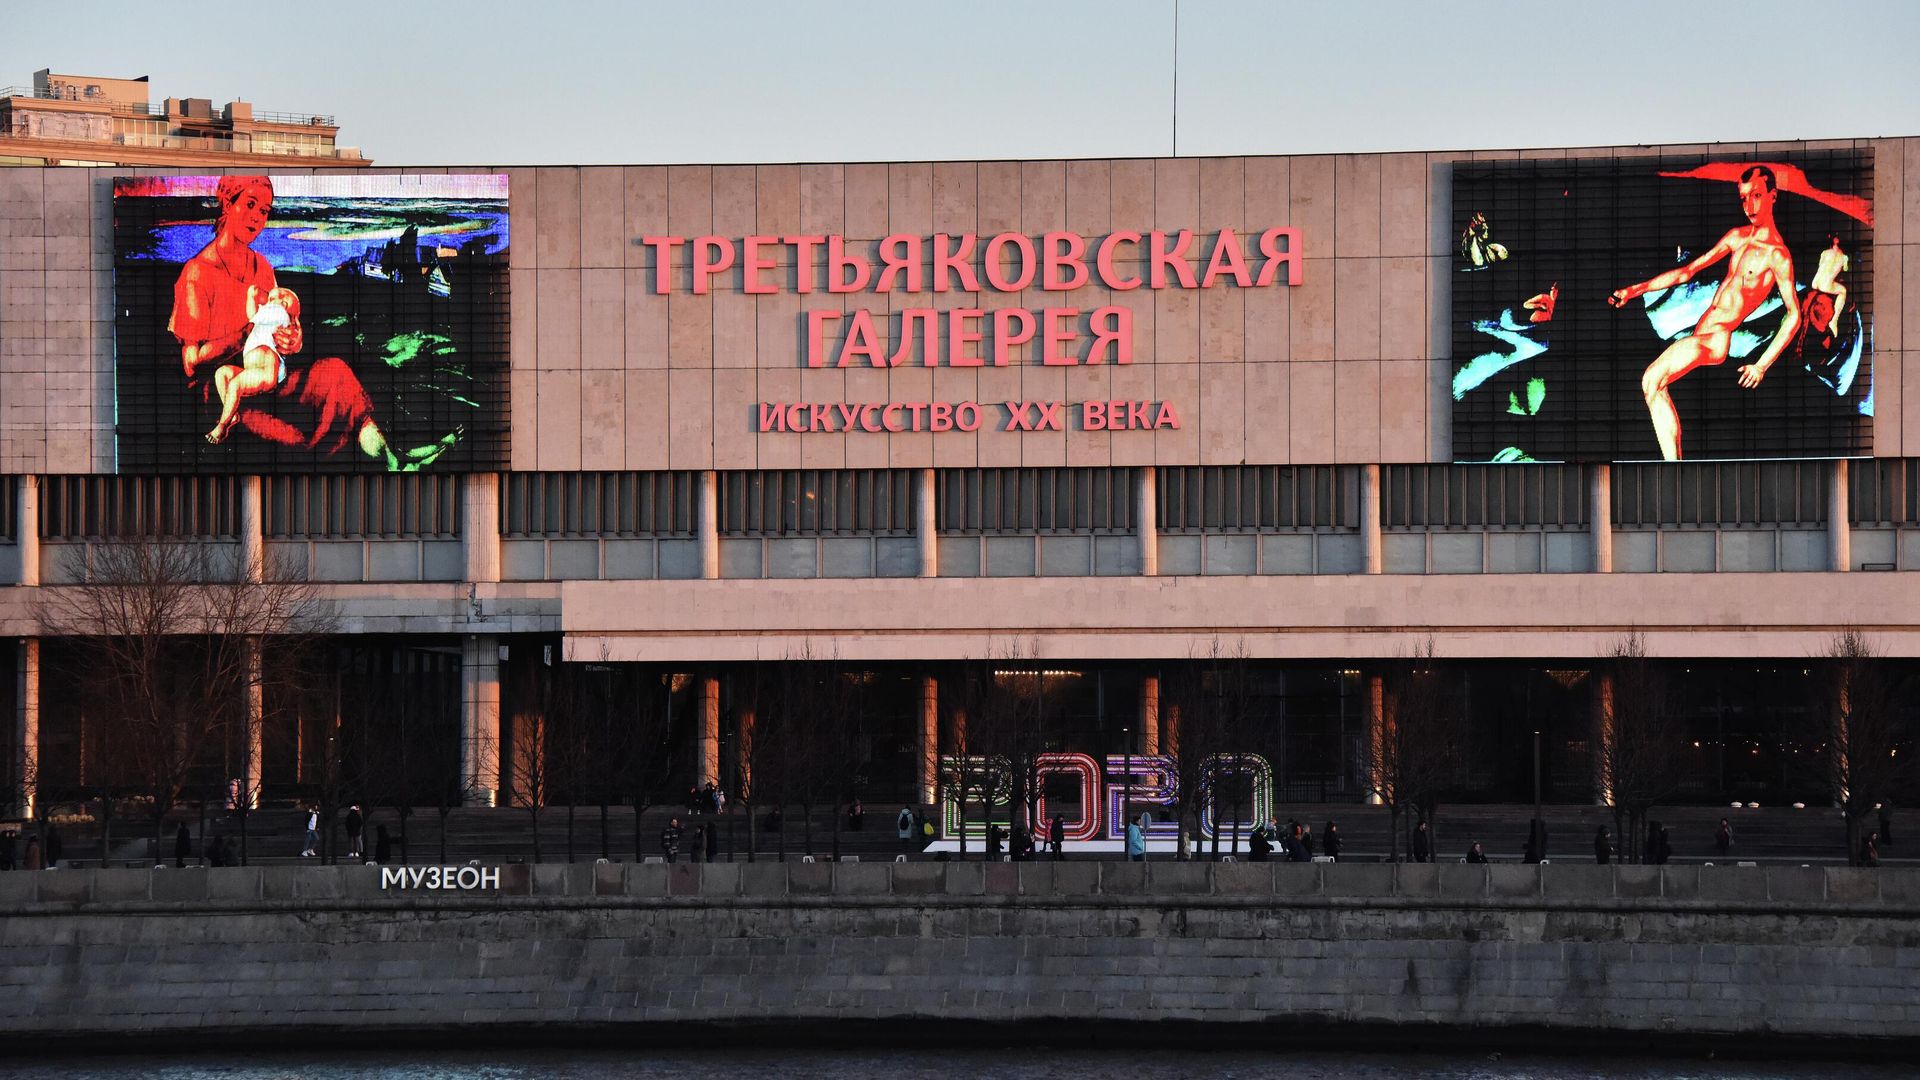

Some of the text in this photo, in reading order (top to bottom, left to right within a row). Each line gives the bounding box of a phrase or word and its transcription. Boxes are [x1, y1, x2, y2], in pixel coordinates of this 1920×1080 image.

[642, 226, 1304, 295] ТРЕТЬЯКОВСКАЯ
[806, 305, 1134, 369] ГАЛЕРЕЯ
[757, 402, 984, 433] ИСКУССТВО
[1082, 399, 1182, 431] ВЕКА
[941, 752, 1273, 841] 2020
[381, 866, 500, 890] МУЗЕОН
